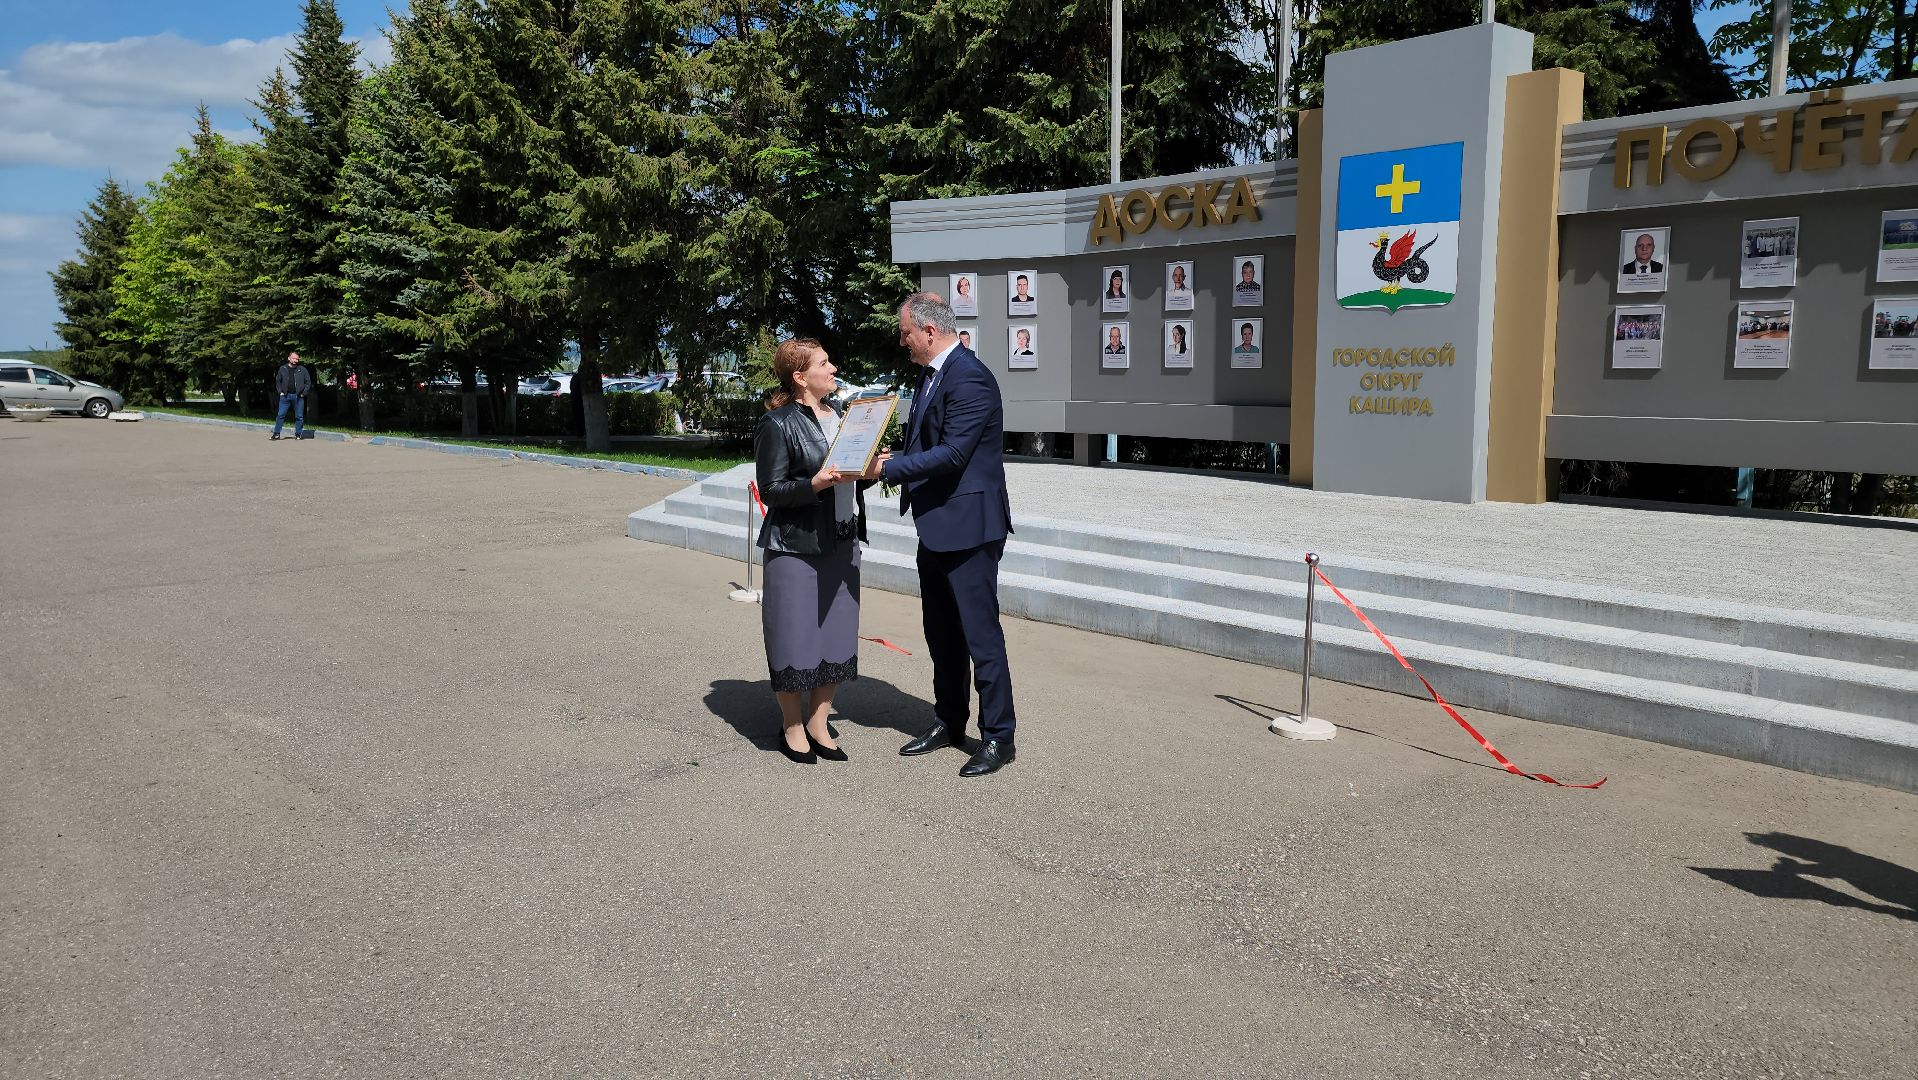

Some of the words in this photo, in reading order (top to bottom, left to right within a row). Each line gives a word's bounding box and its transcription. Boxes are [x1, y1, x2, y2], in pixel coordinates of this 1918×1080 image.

[1090, 176, 1261, 247] ДОСКА
[1332, 341, 1456, 370] ГОРОДСКОЙ
[1360, 371, 1424, 392] ОКРУГ
[1349, 395, 1434, 417] КАШИРА
